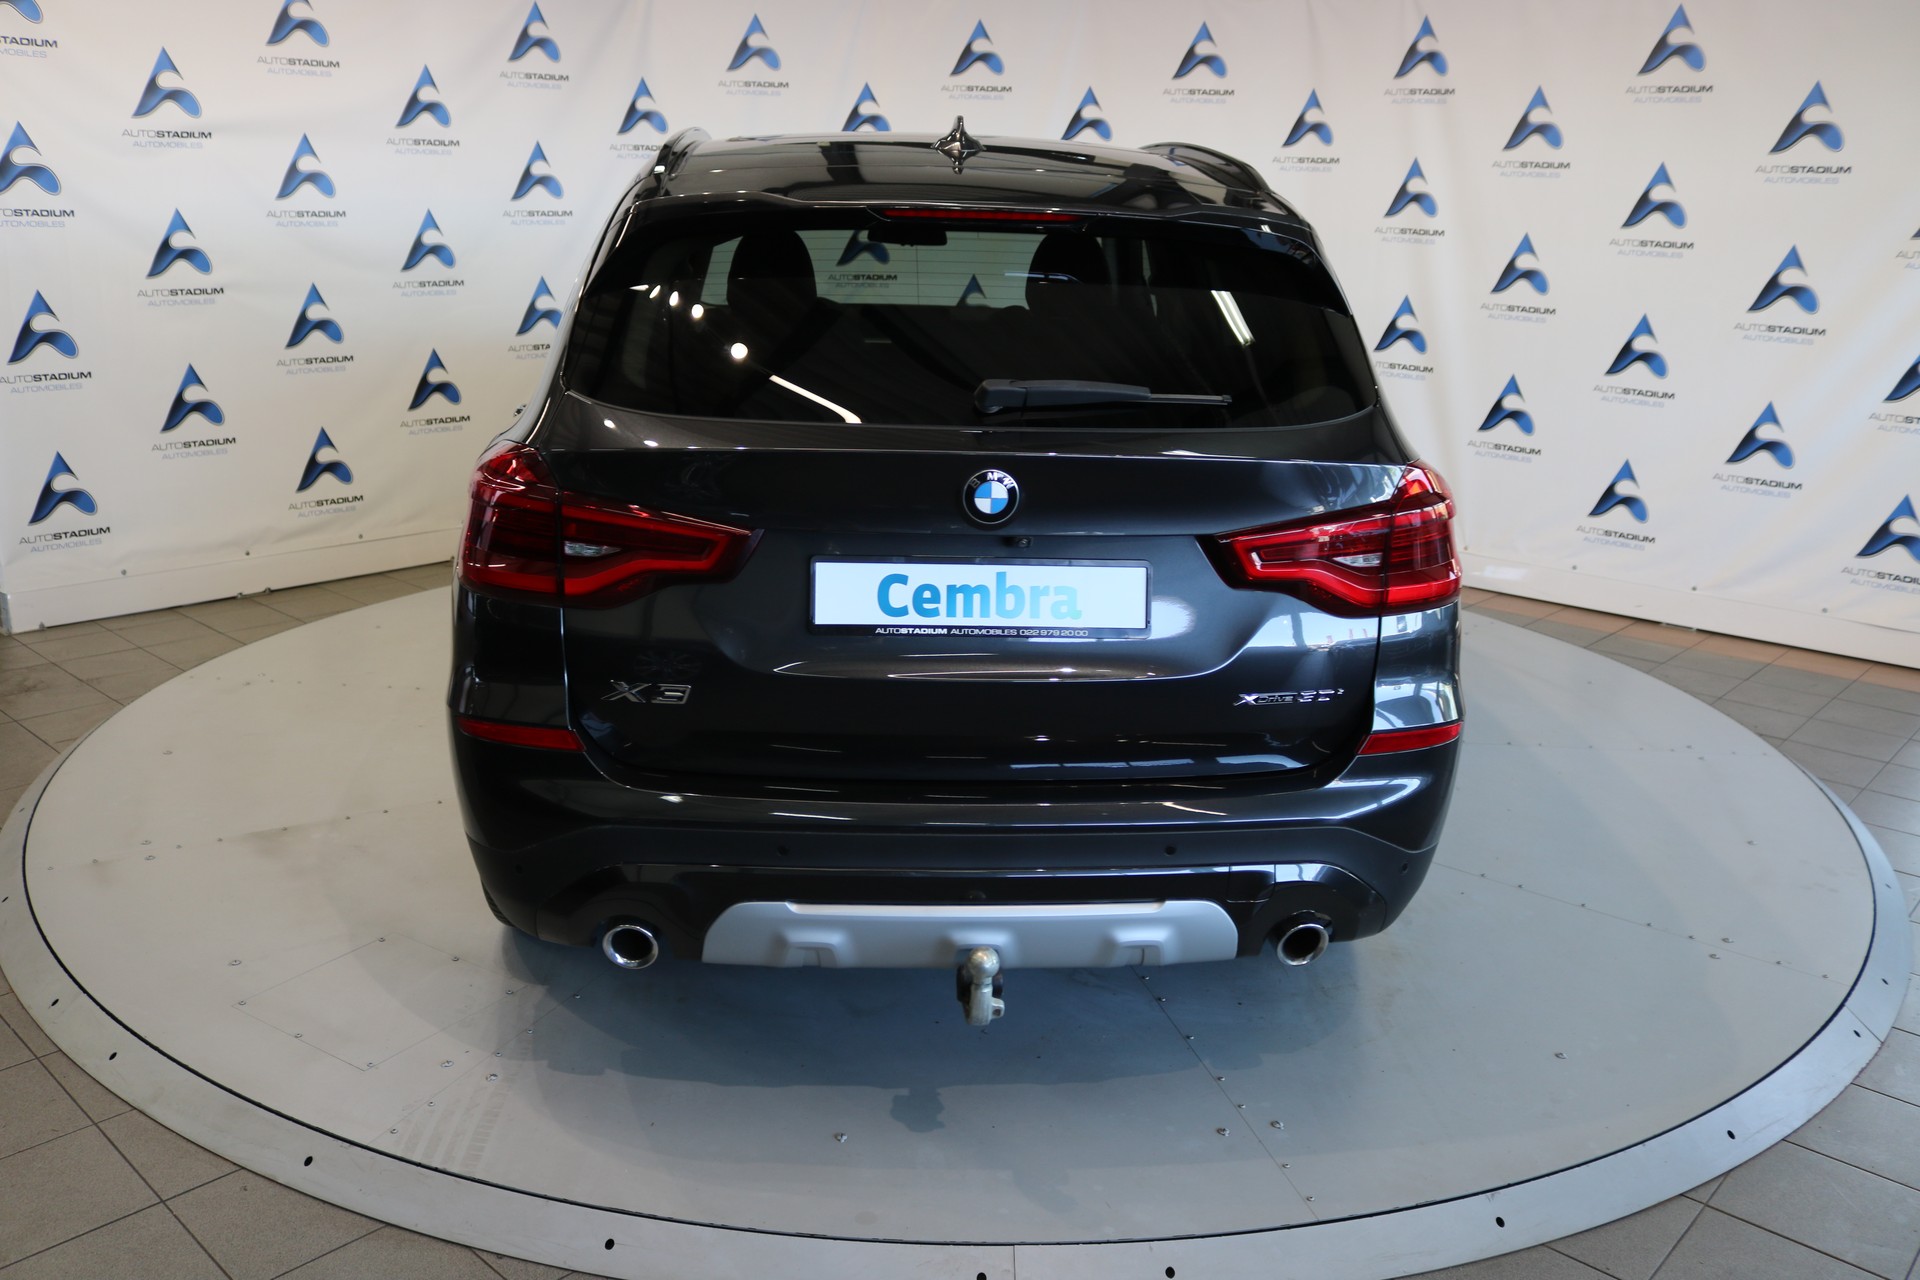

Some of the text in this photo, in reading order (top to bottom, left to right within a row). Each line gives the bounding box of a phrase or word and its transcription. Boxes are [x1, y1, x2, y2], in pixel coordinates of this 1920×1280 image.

[257, 56, 340, 68] AUTOSTADIUM
[500, 71, 569, 81] AUTOSTADIUM
[718, 80, 789, 88] AUTOSTADIUM
[1626, 85, 1713, 94] AUTOSTADIUM
[1163, 88, 1235, 96] AUTOSTADIUM
[122, 129, 212, 139] AUTOSTADIUM
[387, 138, 460, 147] AUTOSTADIUM
[1273, 157, 1340, 165] AUTOSTADIUM
[1493, 161, 1570, 169] AUTOSTADIUM
[1756, 165, 1852, 175] AUTOSTADIUM
[267, 210, 346, 219] AUTOSTADIUM
[502, 210, 573, 218] AUTOSTADIUM
[1374, 227, 1445, 237] AUTOSTADIUM
[1610, 238, 1694, 249] AUTOSTADIUM
[393, 280, 464, 289] AUTOSTADIUM
[137, 287, 224, 298] AUTOSTADIUM
[1480, 302, 1556, 315] AUTOSTADIUM
[1734, 322, 1826, 337] AUTOSTADIUM
[275, 355, 354, 367] AUTOSTADIUM
[0, 371, 92, 384] AUTOSTADIUM
[1593, 384, 1675, 401] AUTOSTADIUM
[400, 415, 470, 427] AUTOSTADIUM
[152, 437, 236, 450] AUTOSTADIUM
[1467, 440, 1542, 456] AUTOSTADIUM
[969, 471, 1016, 489] BMW
[1713, 472, 1803, 490] AUTOSTADIUM
[288, 495, 363, 509] AUTOSTADIUM
[19, 526, 110, 544] AUTOSTADIUM
[1577, 525, 1656, 543] AUTOSTADIUM
[877, 571, 1083, 620] Cembra
[875, 627, 947, 635] AUTOSTADIUM
[950, 628, 1017, 636] AUTOMOBILES
[1019, 628, 1040, 637] 022
[1040, 629, 1060, 637] 979
[599, 679, 692, 704] X3
